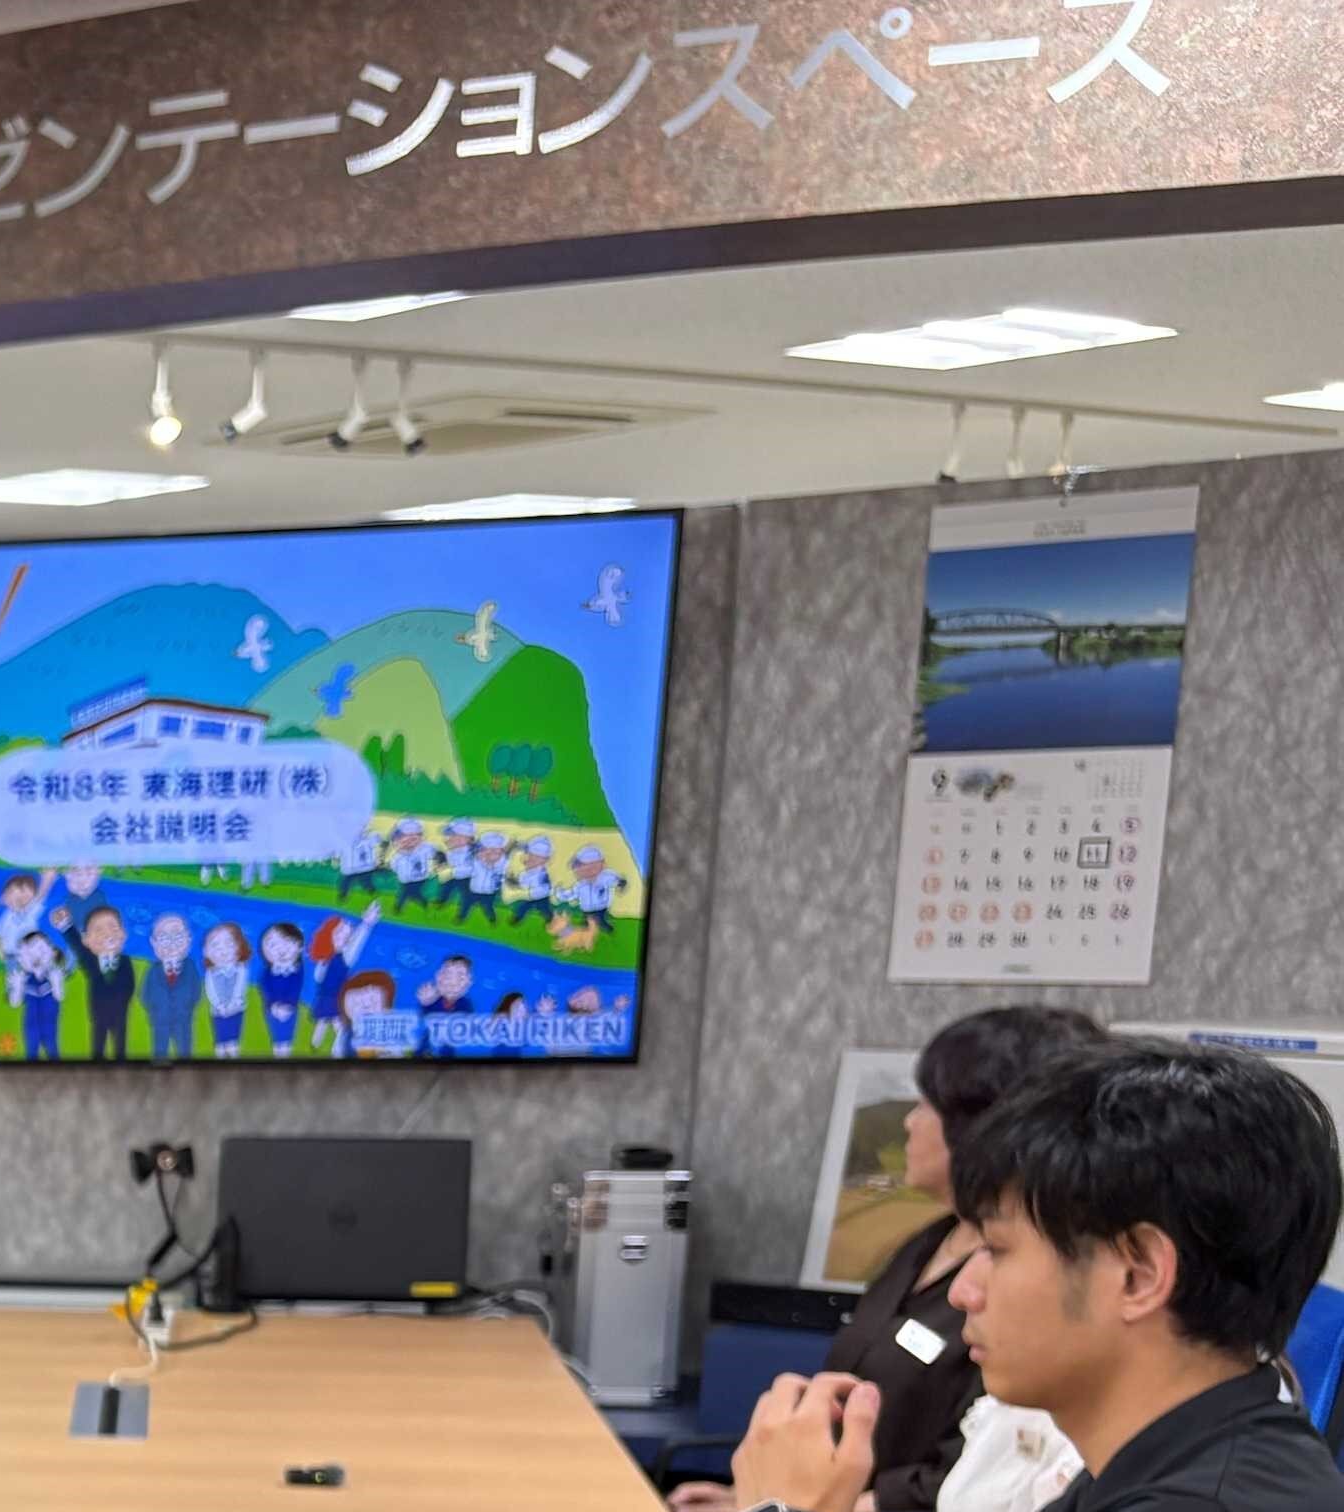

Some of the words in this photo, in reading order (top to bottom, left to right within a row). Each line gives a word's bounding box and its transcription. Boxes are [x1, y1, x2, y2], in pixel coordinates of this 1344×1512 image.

[92, 810, 253, 845] 会社説明会
[428, 1017, 520, 1044] TOKAI
[530, 1017, 626, 1044] RIKEN
